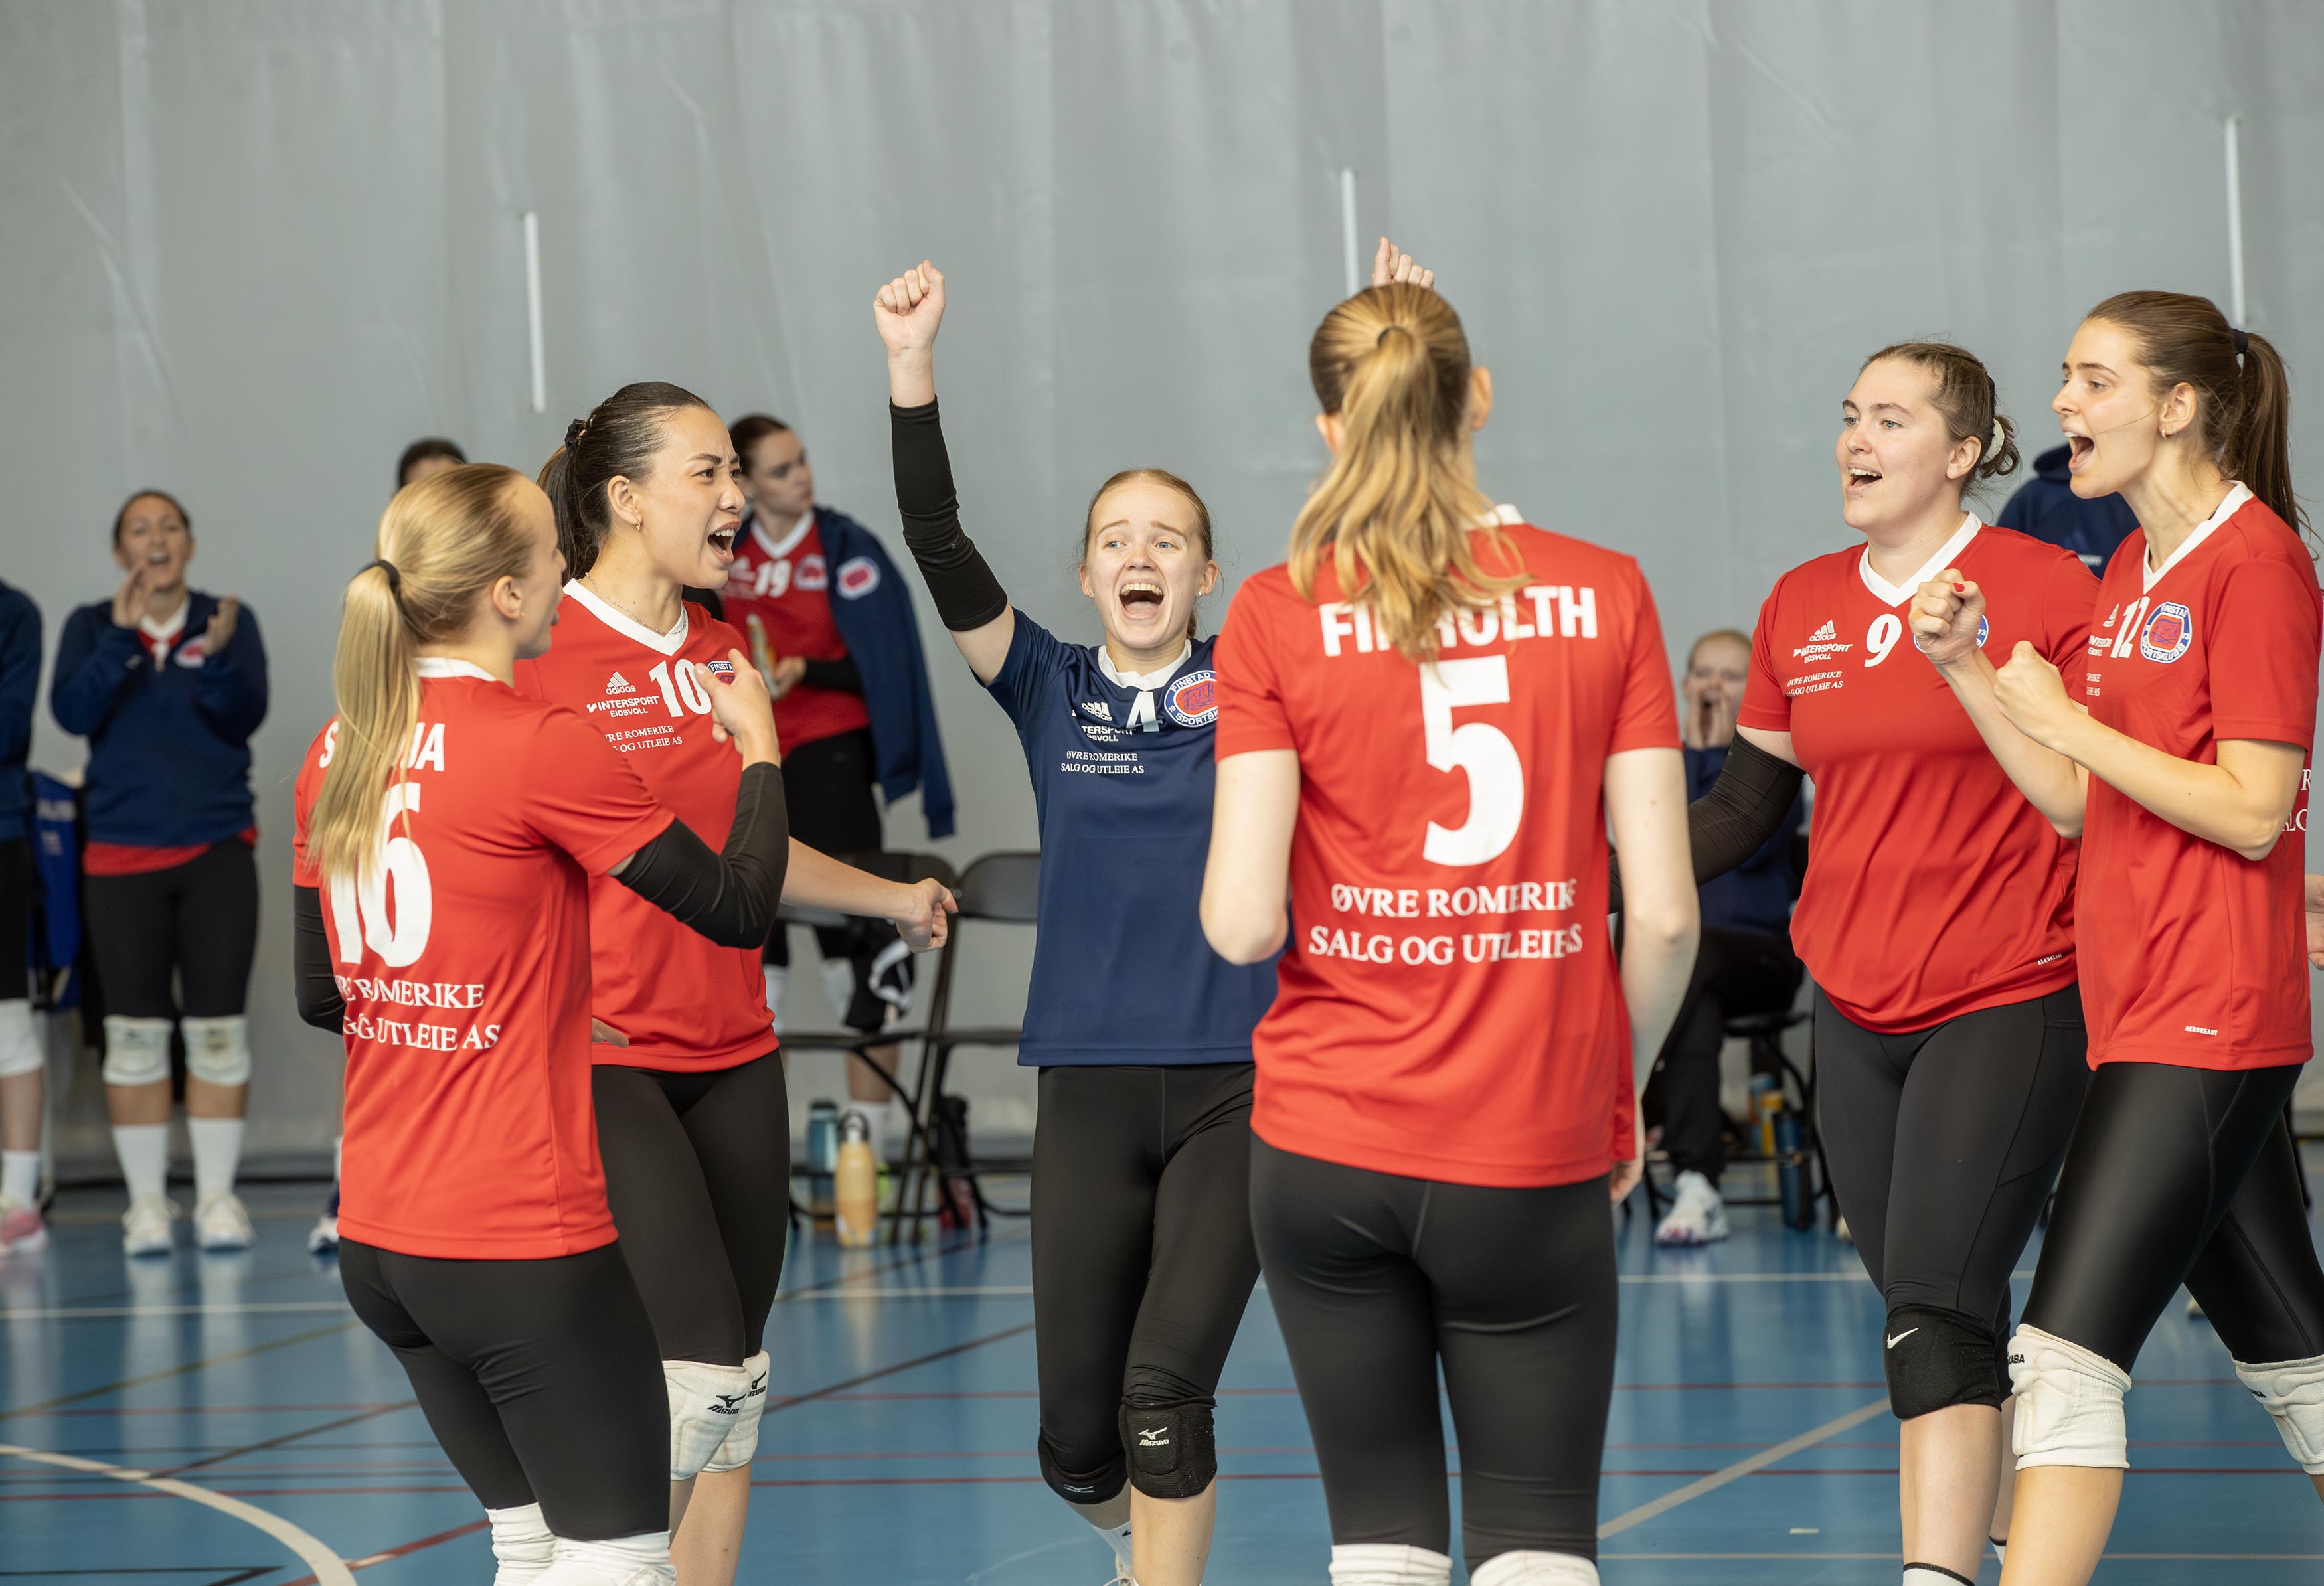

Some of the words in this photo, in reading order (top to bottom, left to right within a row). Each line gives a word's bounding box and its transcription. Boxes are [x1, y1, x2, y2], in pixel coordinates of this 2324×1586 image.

[2110, 596, 2150, 658] 12
[1809, 632, 1837, 642] adidas
[1865, 613, 1902, 667] 9
[1800, 643, 1853, 657] INTERSPORT
[710, 663, 733, 672] FINSTA
[1171, 671, 1212, 692] FINSTAD
[1803, 671, 1843, 684] ROMERIKE
[1831, 680, 1844, 689] AS
[605, 684, 637, 695] adidas
[648, 659, 712, 718] 10
[597, 696, 659, 712] INTERSPORT
[610, 707, 649, 718] EIDSVOLL
[1175, 709, 1219, 725] SPORTSK
[624, 725, 675, 739] ROMERIKE
[620, 742, 636, 752] OG
[637, 736, 671, 750] UTLEIE
[671, 736, 683, 745] AS
[1066, 750, 1088, 760] ØVRE
[1089, 753, 1138, 761] ROMERIKE
[1420, 655, 1524, 866] 5
[1060, 763, 1080, 772] SALG
[1082, 764, 1096, 773] OG
[1097, 765, 1130, 774] UTLEIE
[1131, 765, 1145, 774] AS
[1331, 882, 1420, 918] ØVRE
[1307, 925, 1394, 964] SALG
[1400, 936, 1455, 965] OG
[376, 1017, 458, 1052] UTLEIE
[461, 1024, 501, 1050] AS
[2184, 1025, 2218, 1036] AEROREADY
